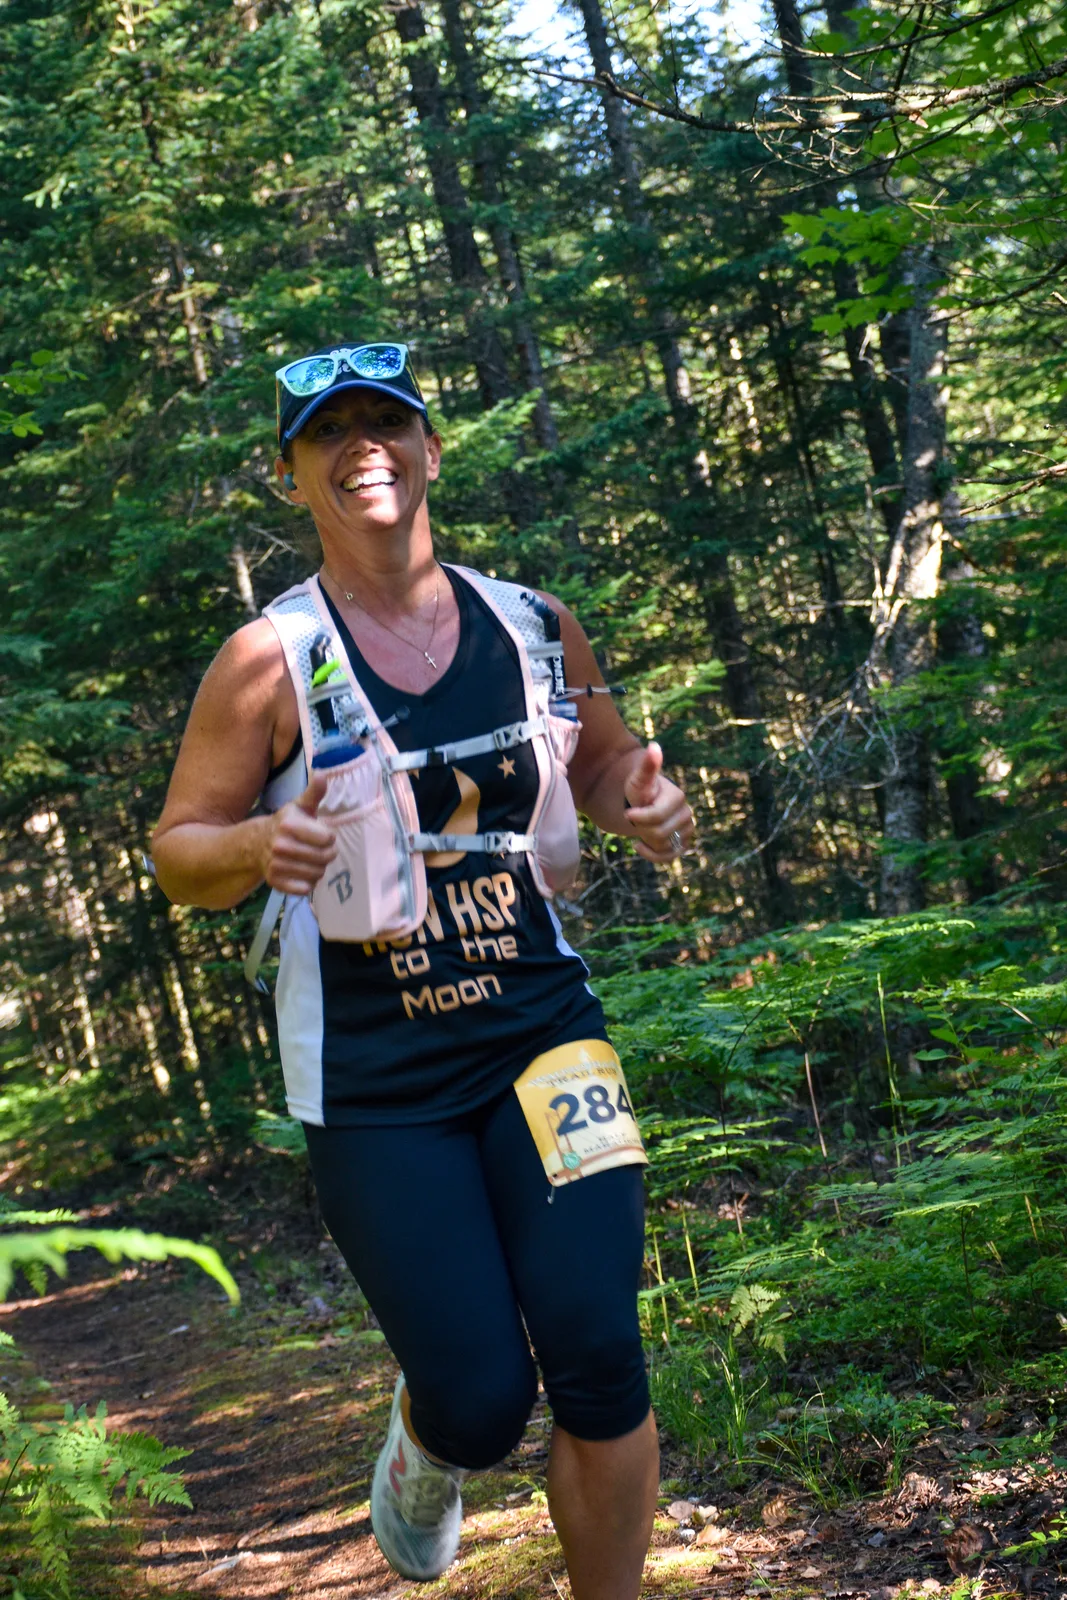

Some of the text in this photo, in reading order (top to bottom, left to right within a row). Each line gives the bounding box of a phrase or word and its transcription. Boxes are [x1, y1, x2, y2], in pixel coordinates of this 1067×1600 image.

[445, 872, 516, 937] HSP
[390, 934, 519, 980] to the
[401, 973, 503, 1021] Moon
[548, 1083, 636, 1137] 284
